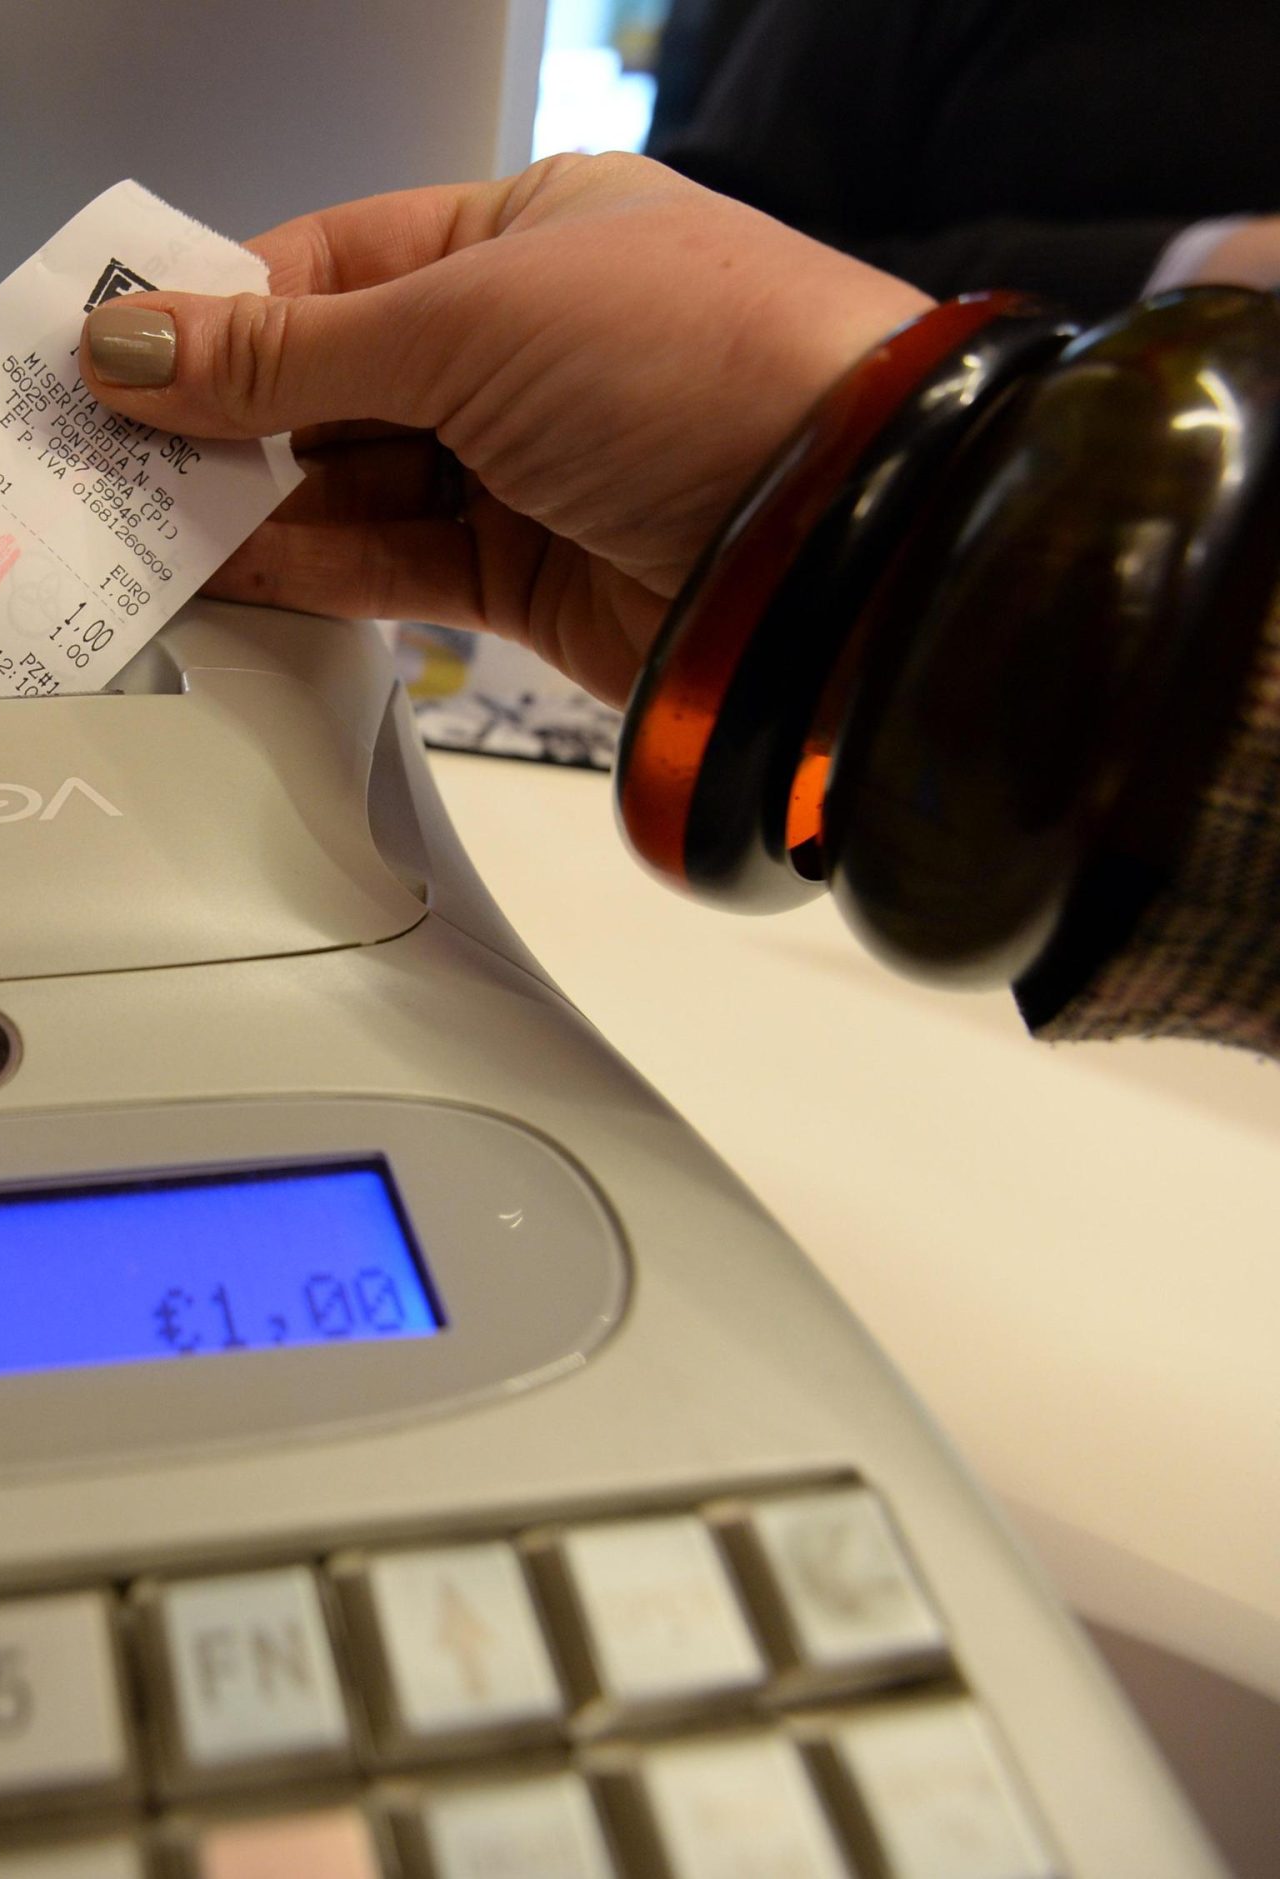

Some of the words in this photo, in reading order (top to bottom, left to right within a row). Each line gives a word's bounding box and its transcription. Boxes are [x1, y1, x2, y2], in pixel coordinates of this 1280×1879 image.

[2, 355, 51, 412] 56025
[51, 414, 135, 500] PONTEDERA
[140, 502, 179, 540] (PI)
[23, 351, 130, 470] MISERICORDIA
[71, 377, 99, 415] VIA
[102, 415, 150, 466] DELLA
[160, 435, 202, 475] SNC
[0, 411, 17, 429] E
[72, 482, 173, 582] 01681260509
[6, 389, 36, 430] TEL.
[48, 436, 91, 474] 0587
[92, 478, 142, 529] 59946
[110, 564, 151, 606] EURO
[19, 651, 60, 695] PZ#1
[190, 1616, 315, 1705] FN
